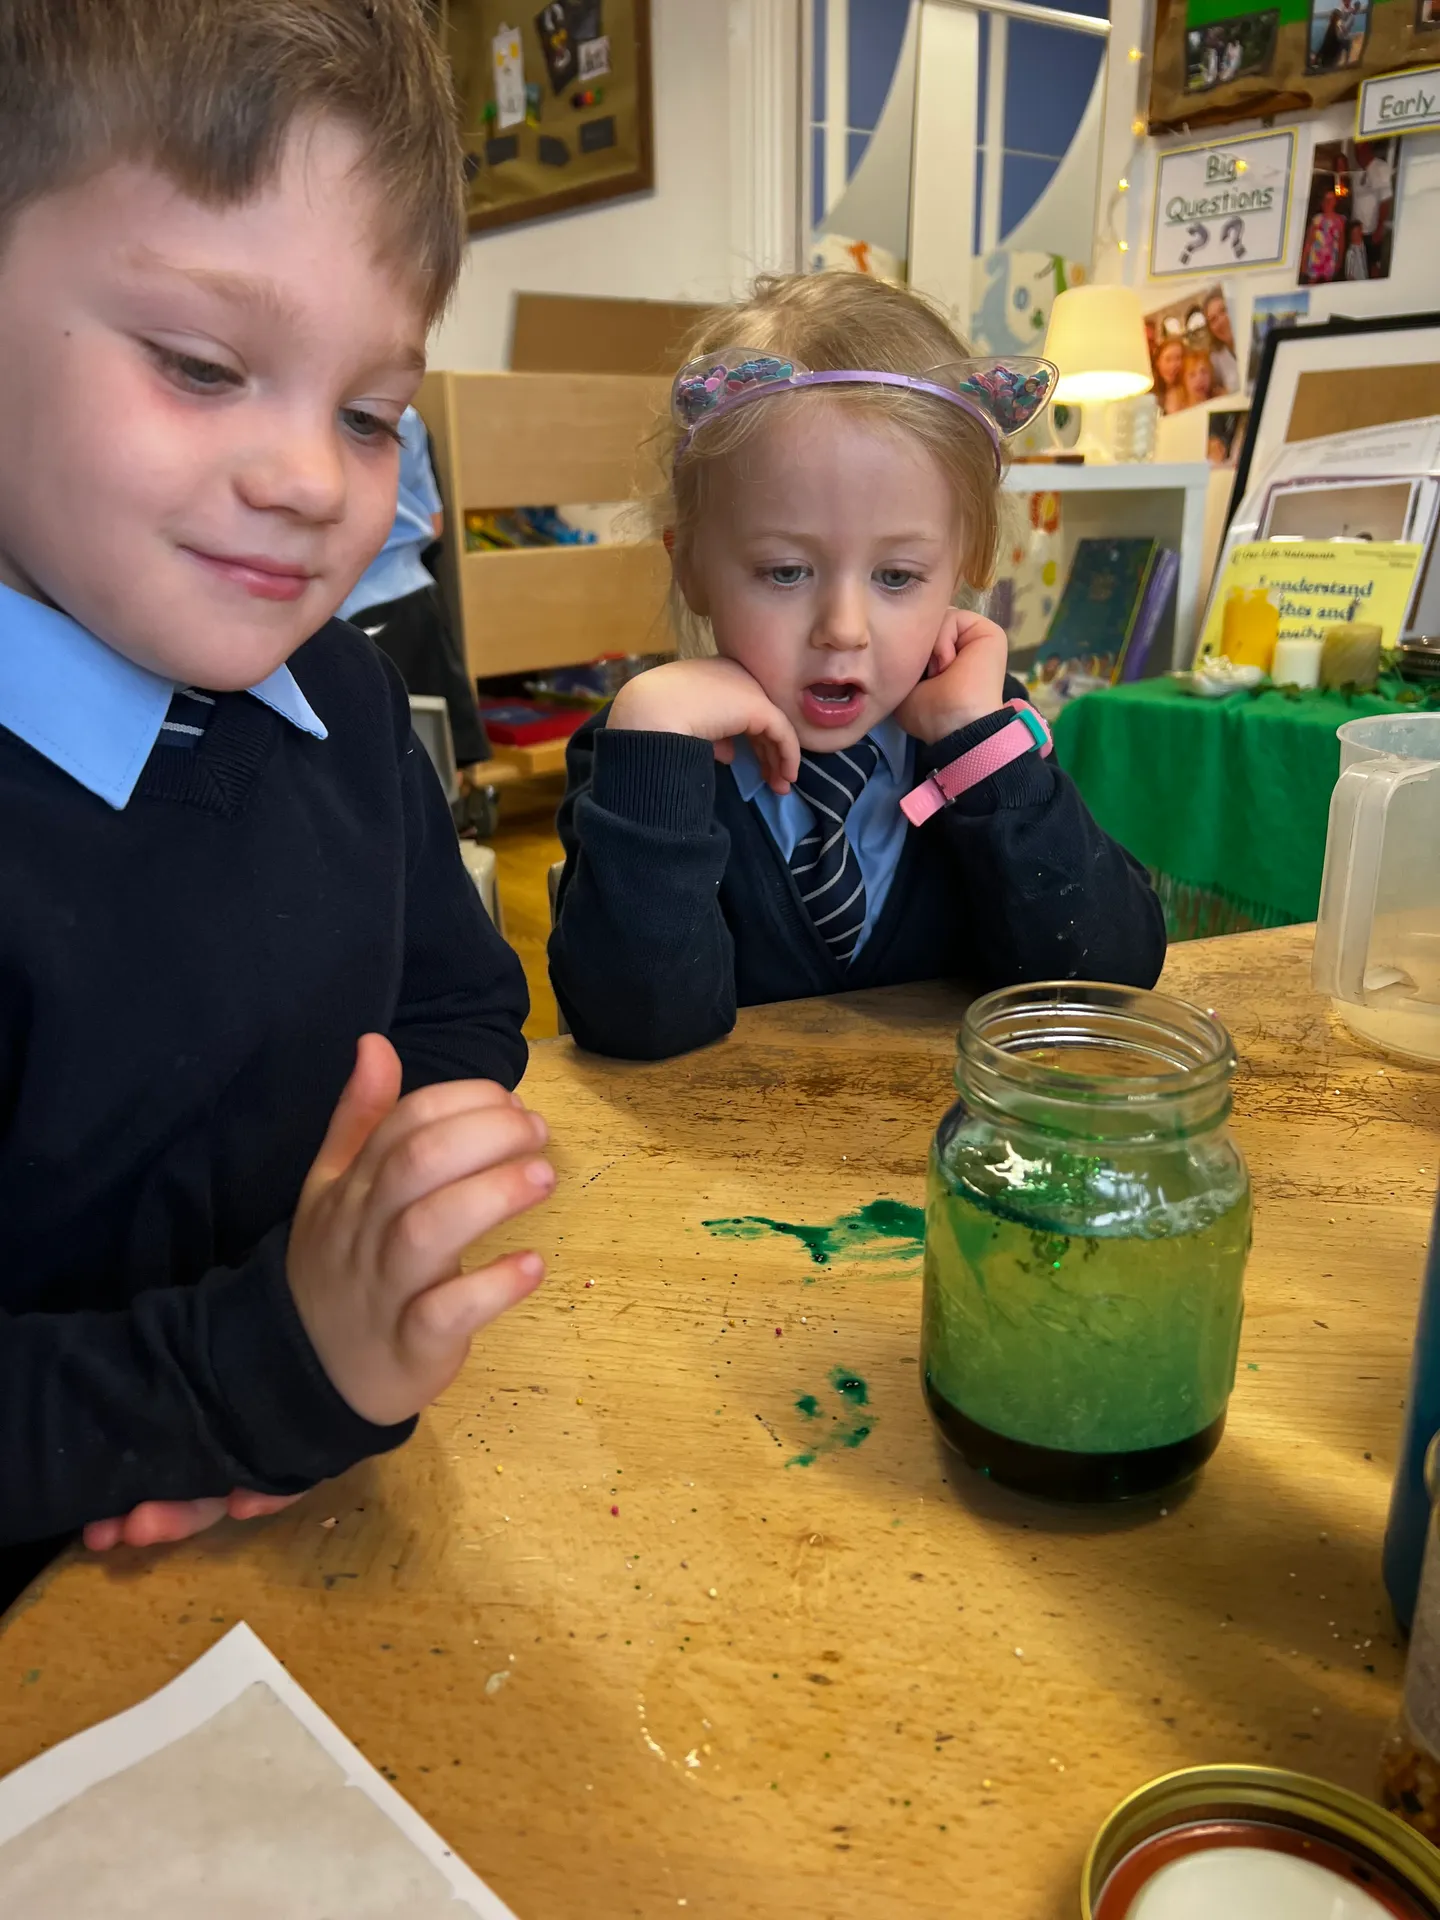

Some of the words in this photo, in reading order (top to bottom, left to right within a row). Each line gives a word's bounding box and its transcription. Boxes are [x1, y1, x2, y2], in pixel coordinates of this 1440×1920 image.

[1379, 89, 1436, 118] Early
[1205, 154, 1238, 183] Big
[1165, 187, 1274, 222] Questions
